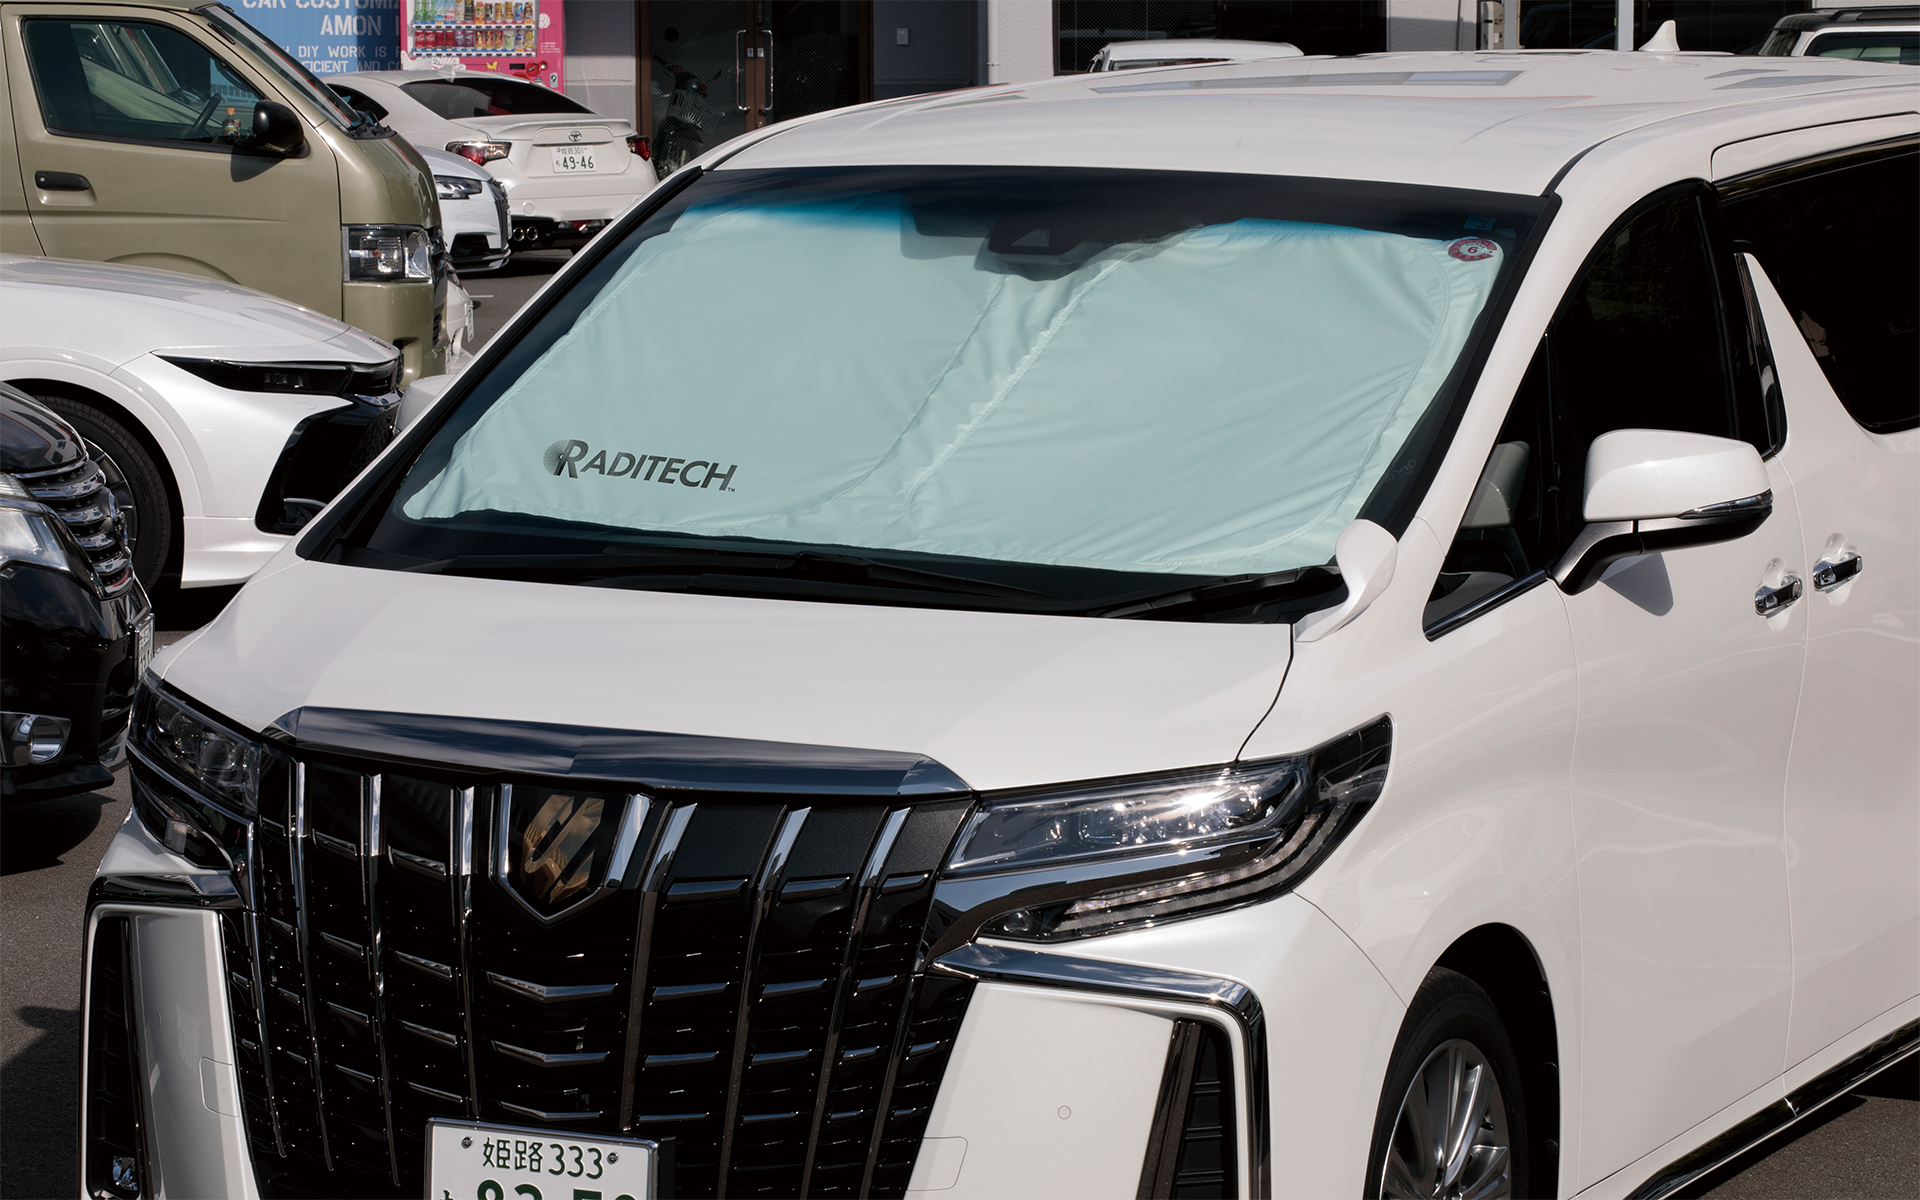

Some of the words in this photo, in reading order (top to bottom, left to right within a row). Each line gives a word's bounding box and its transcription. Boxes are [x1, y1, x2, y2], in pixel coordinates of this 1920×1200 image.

[320, 15, 381, 35] AMON
[298, 46, 319, 57] DIY
[328, 46, 366, 57] WORK
[375, 46, 387, 57] IS
[356, 61, 379, 71] AND
[563, 156, 593, 169] 49-46
[553, 439, 738, 491] RADITECH
